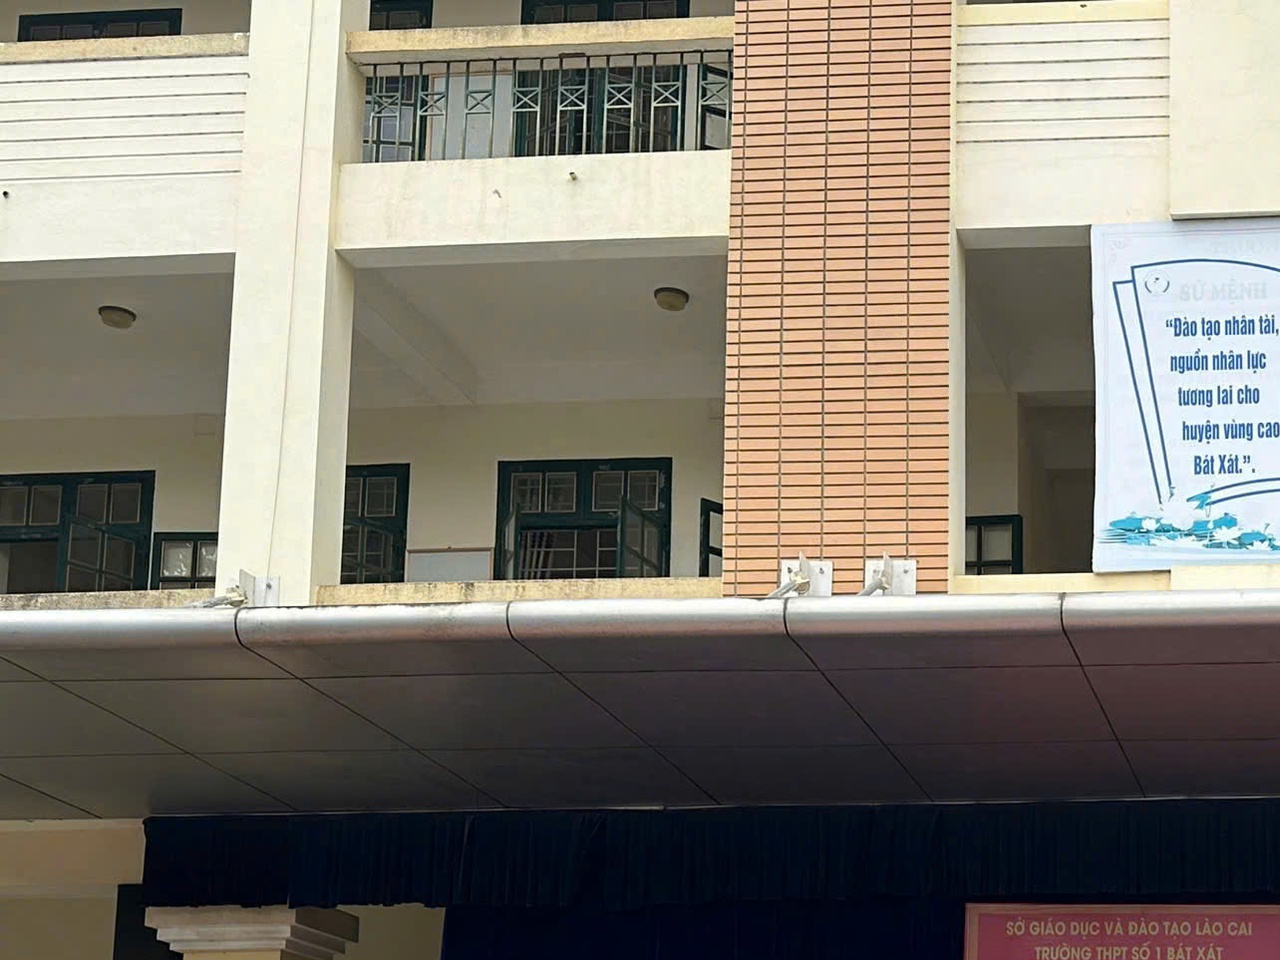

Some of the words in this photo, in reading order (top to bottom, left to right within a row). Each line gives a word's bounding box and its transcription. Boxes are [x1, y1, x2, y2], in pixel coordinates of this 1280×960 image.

[1201, 317, 1221, 341] tạo
[1225, 315, 1255, 336] nhân
[1259, 314, 1279, 336] tài,
[1170, 347, 1208, 374] nguồn
[1212, 350, 1243, 371] nhân
[1247, 350, 1266, 374] lực
[1178, 387, 1213, 407] tương
[1217, 385, 1233, 405] lai
[1237, 384, 1260, 404] cho
[1182, 420, 1220, 444] huyện
[1223, 419, 1253, 441] vùng
[1257, 421, 1280, 439] cao
[1194, 454, 1214, 475] Bát
[1006, 917, 1025, 936] SỞ
[1030, 917, 1066, 936] GIÁO
[1070, 921, 1100, 940] DỤC
[1105, 917, 1124, 936] VÀ
[1128, 917, 1159, 936] ĐÀO
[1163, 921, 1191, 940] TẠO
[1195, 917, 1223, 936] LÀO
[1227, 921, 1253, 936] CAI
[1034, 942, 1092, 960] TRƯỜNG
[1095, 946, 1128, 960] THPT
[1131, 940, 1151, 960] SỐ
[1155, 946, 1161, 960] 1
[1167, 943, 1193, 960] BÁT
[1196, 943, 1224, 960] XÁT
